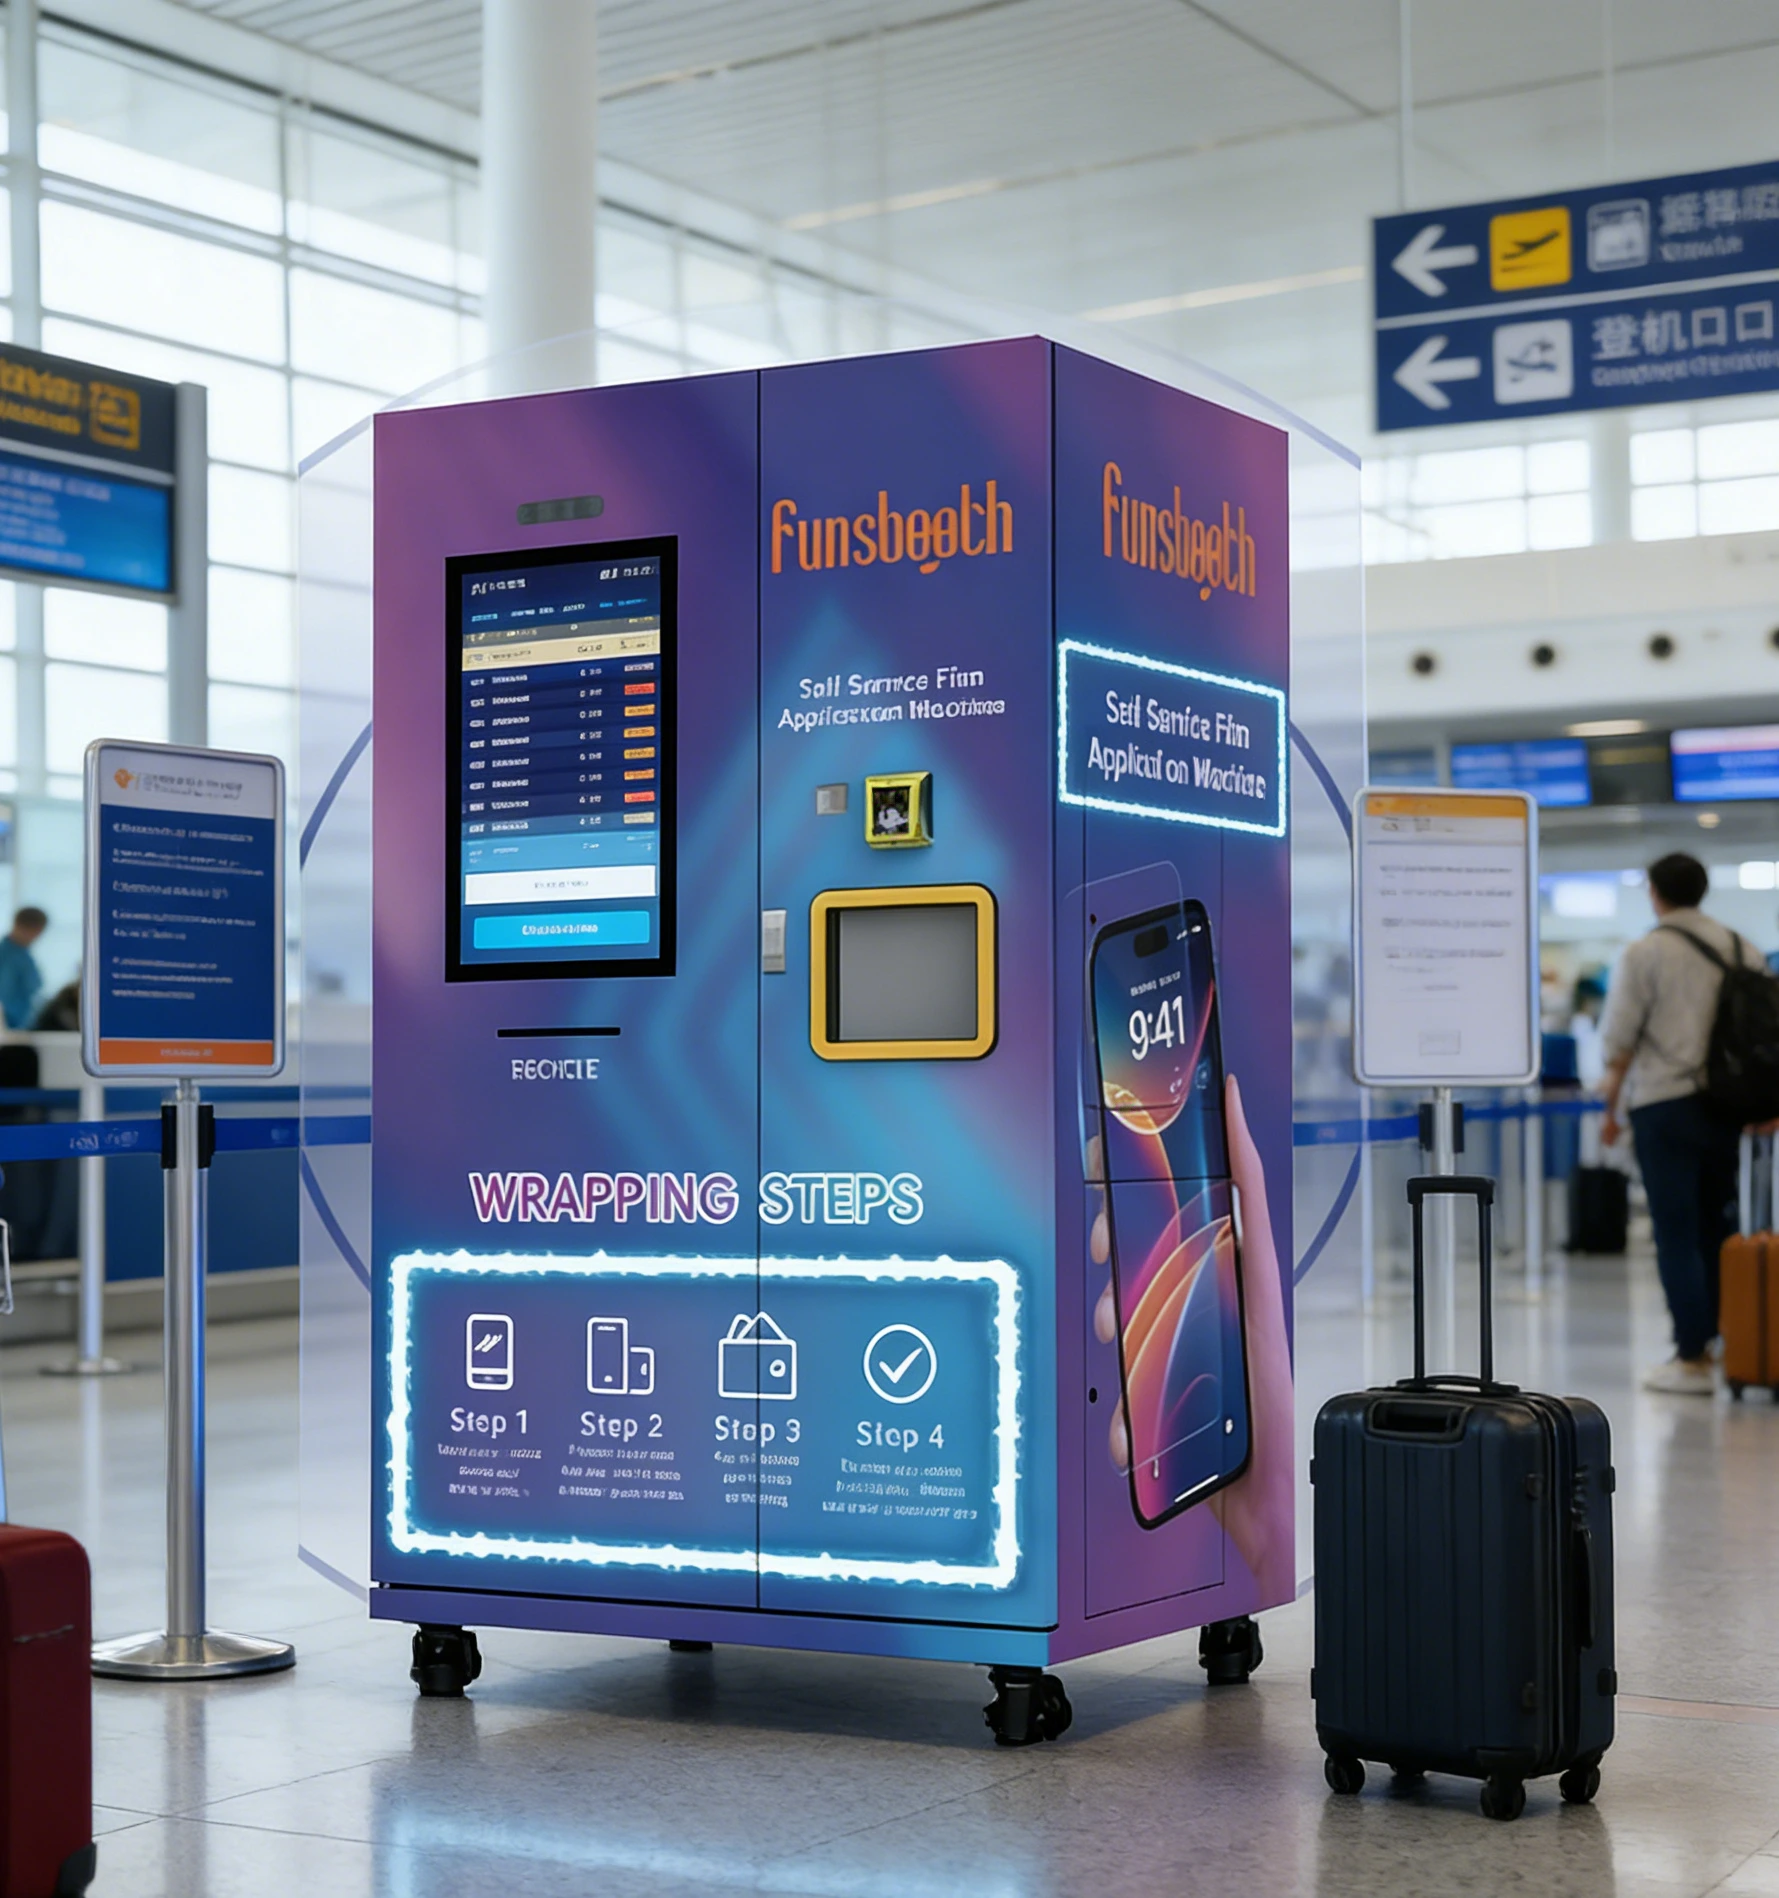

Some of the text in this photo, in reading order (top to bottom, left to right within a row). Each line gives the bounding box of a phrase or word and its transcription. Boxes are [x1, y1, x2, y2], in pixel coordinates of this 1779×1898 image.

[1129, 995, 1185, 1060] 9:41
[469, 1171, 924, 1225] WRAPPING STEPS
[516, 1409, 527, 1434] 1
[580, 1410, 663, 1442] Step 2
[785, 1418, 801, 1443] 3
[929, 1424, 944, 1449] 4
